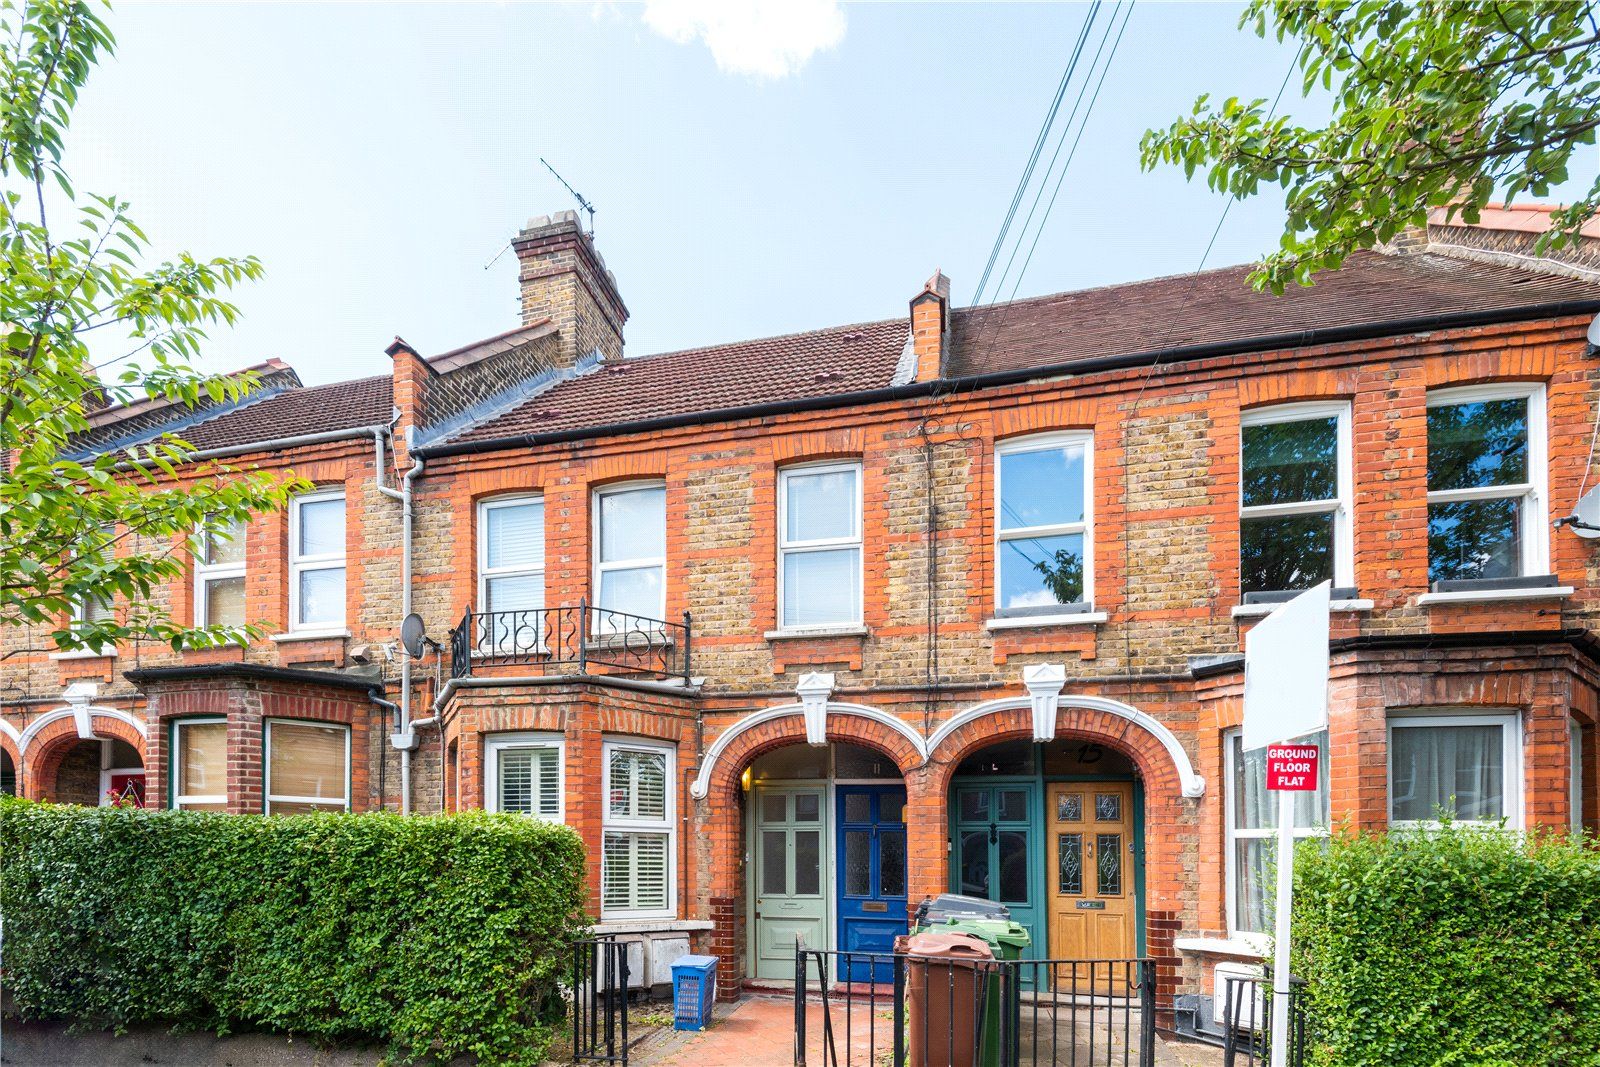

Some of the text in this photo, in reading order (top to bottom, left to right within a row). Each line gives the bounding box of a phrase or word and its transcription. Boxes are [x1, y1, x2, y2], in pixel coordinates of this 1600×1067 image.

[1078, 743, 1103, 764] 15
[1268, 749, 1317, 759] GROUND
[1273, 762, 1311, 773] FLOOR
[1277, 776, 1306, 786] FLAT
